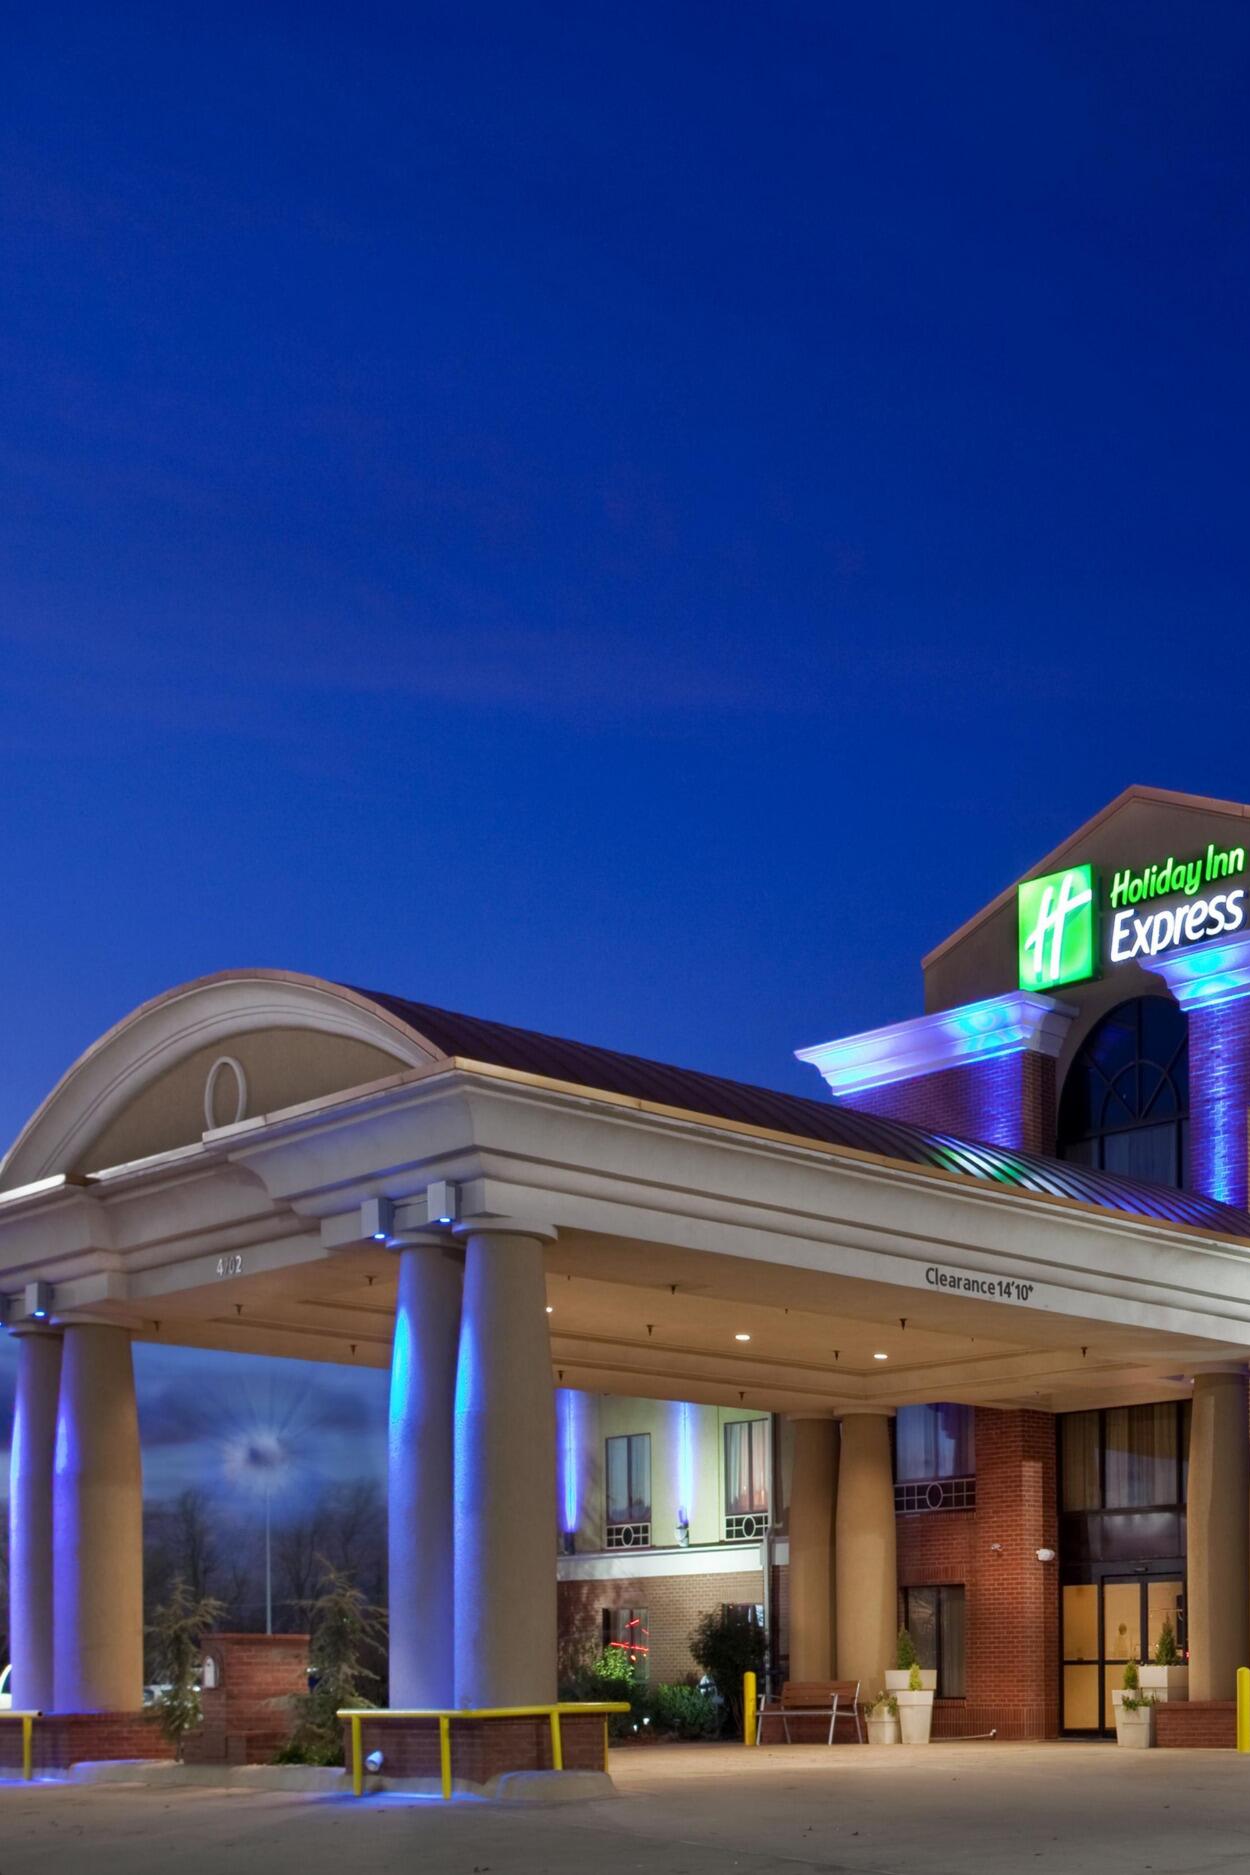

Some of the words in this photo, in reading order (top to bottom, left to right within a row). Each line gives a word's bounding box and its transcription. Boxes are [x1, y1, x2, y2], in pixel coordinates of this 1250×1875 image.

[1110, 857, 1202, 908] Holiday
[1205, 844, 1245, 881] Inn
[1110, 889, 1245, 963] Express
[925, 1267, 996, 1296] Clearance
